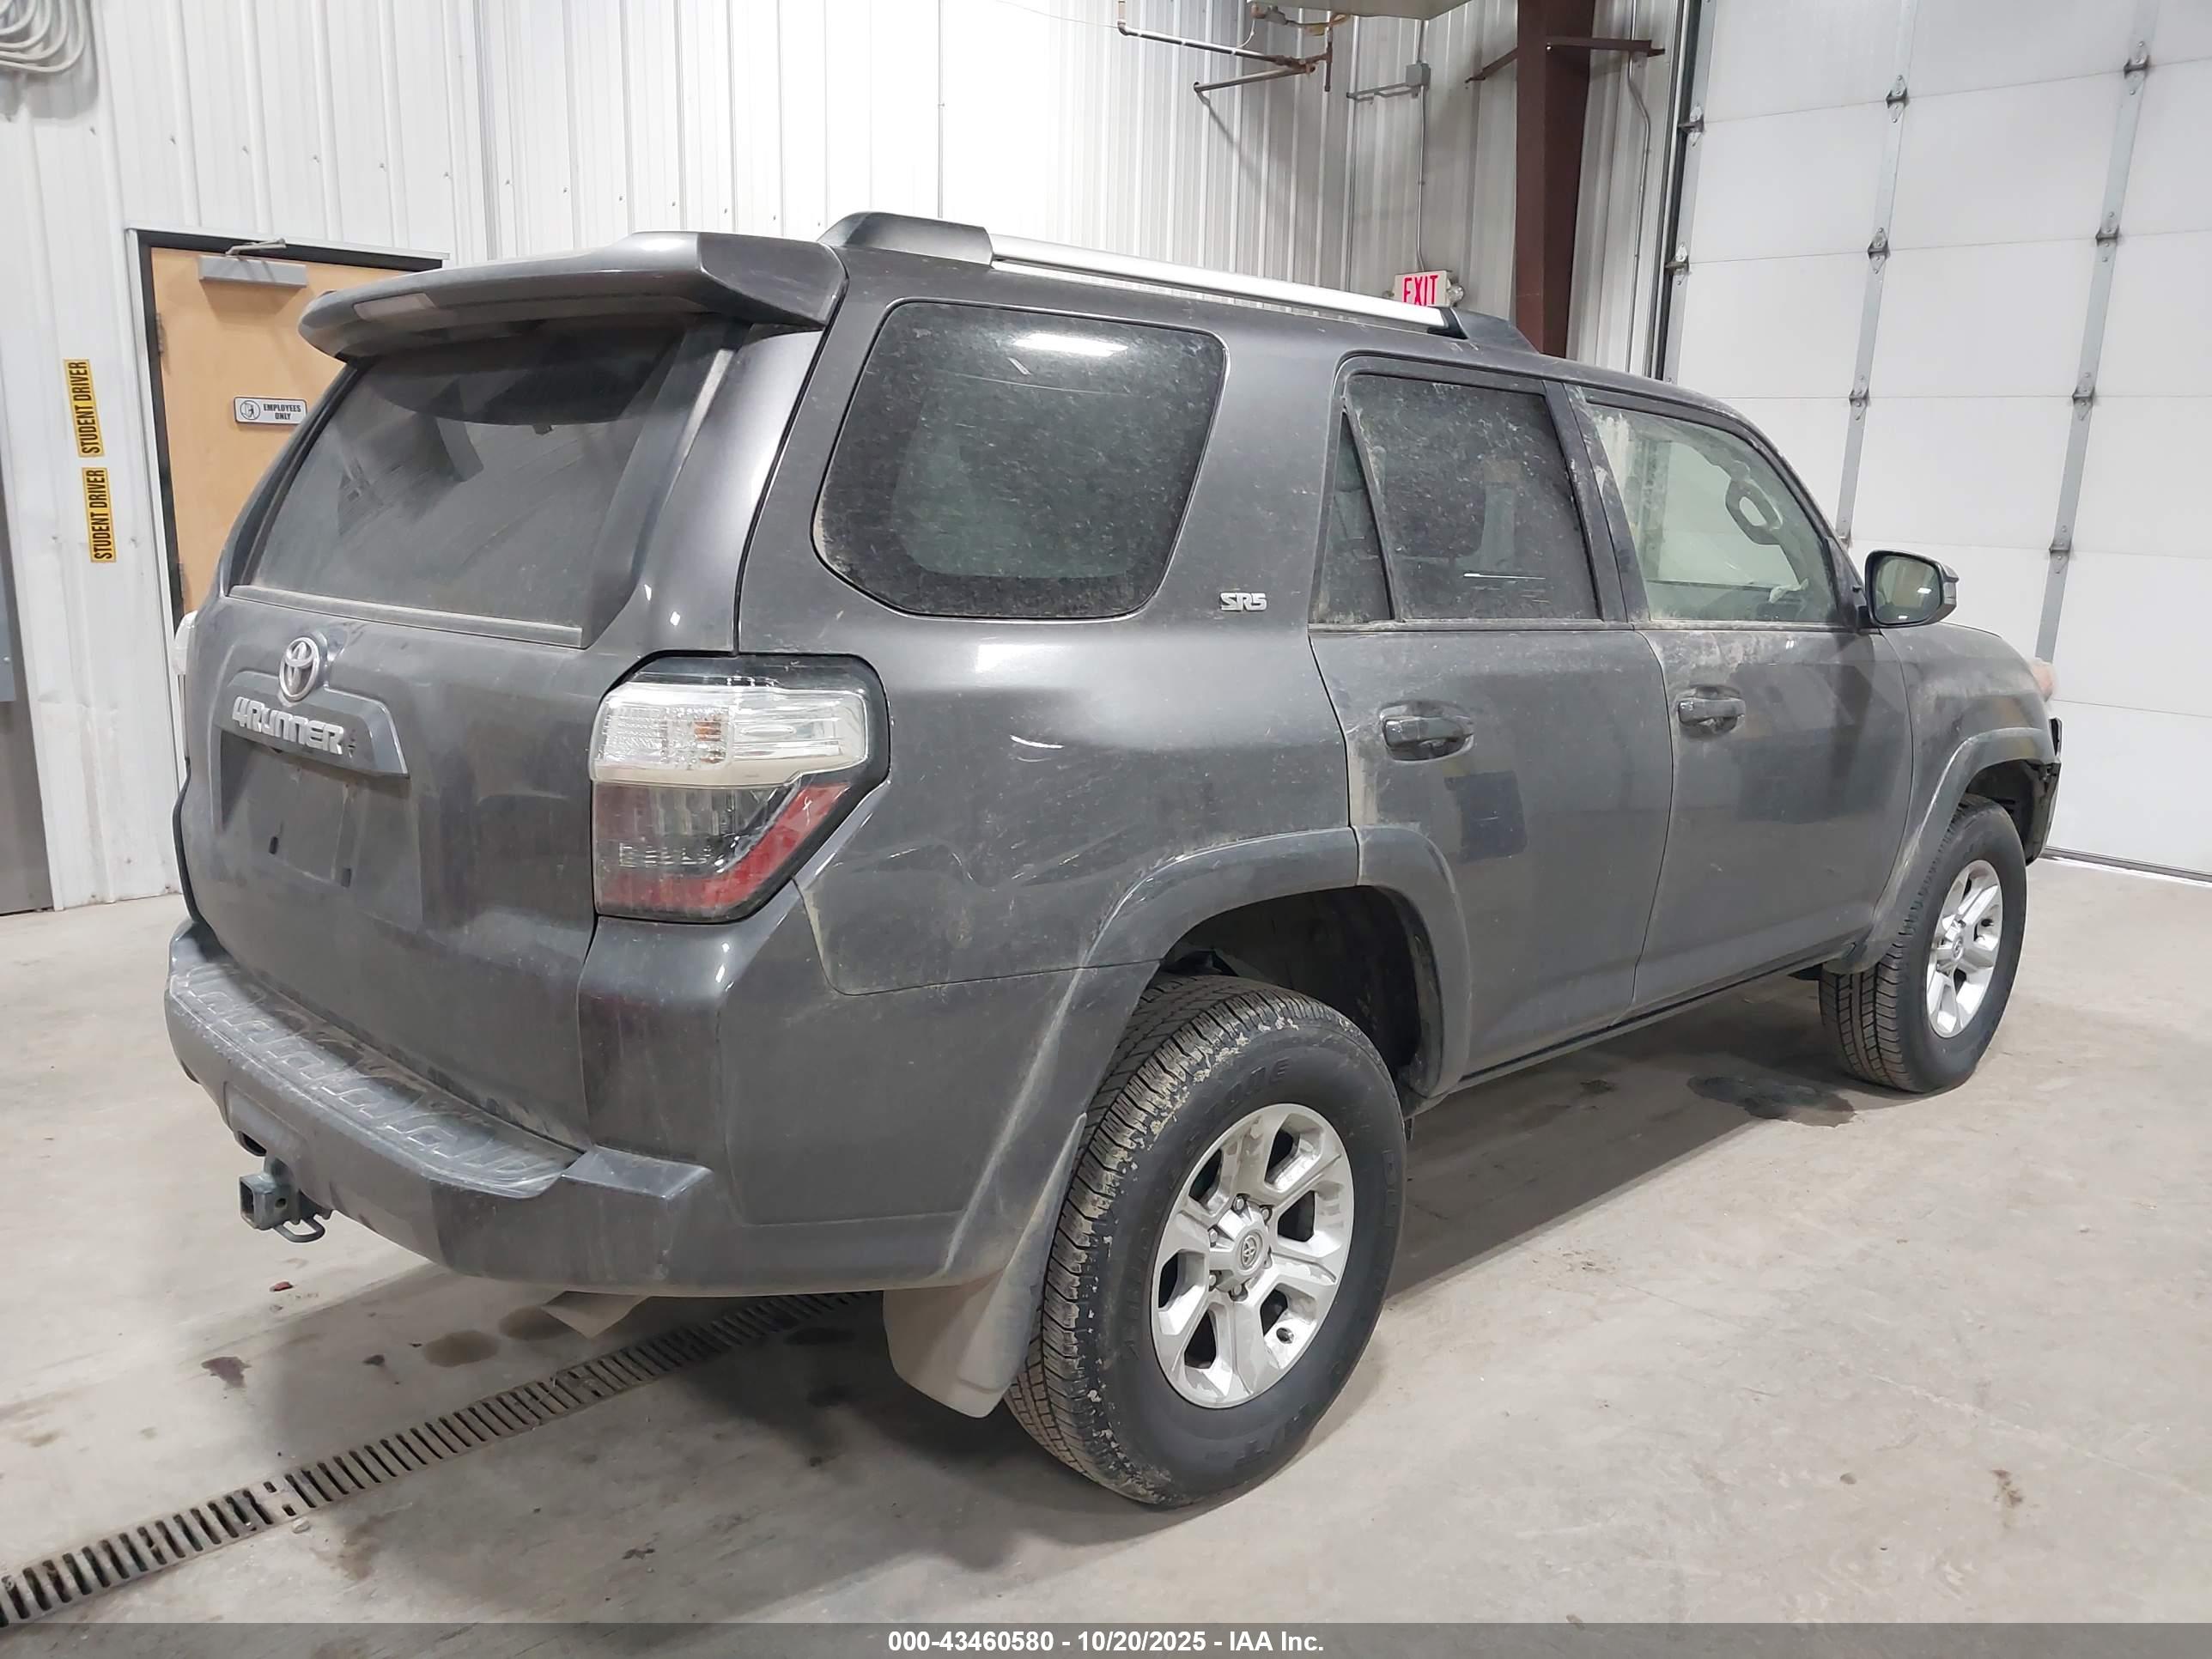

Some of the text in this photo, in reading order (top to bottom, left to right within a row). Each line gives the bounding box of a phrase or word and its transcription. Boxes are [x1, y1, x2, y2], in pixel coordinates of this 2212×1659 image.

[1403, 275, 1438, 306] EXIT
[68, 362, 100, 453] STUDENT DRIVER
[263, 404, 301, 412] EMPLOYEES
[86, 470, 112, 559] STUDENT DRIVER
[1220, 592, 1267, 611] SR5
